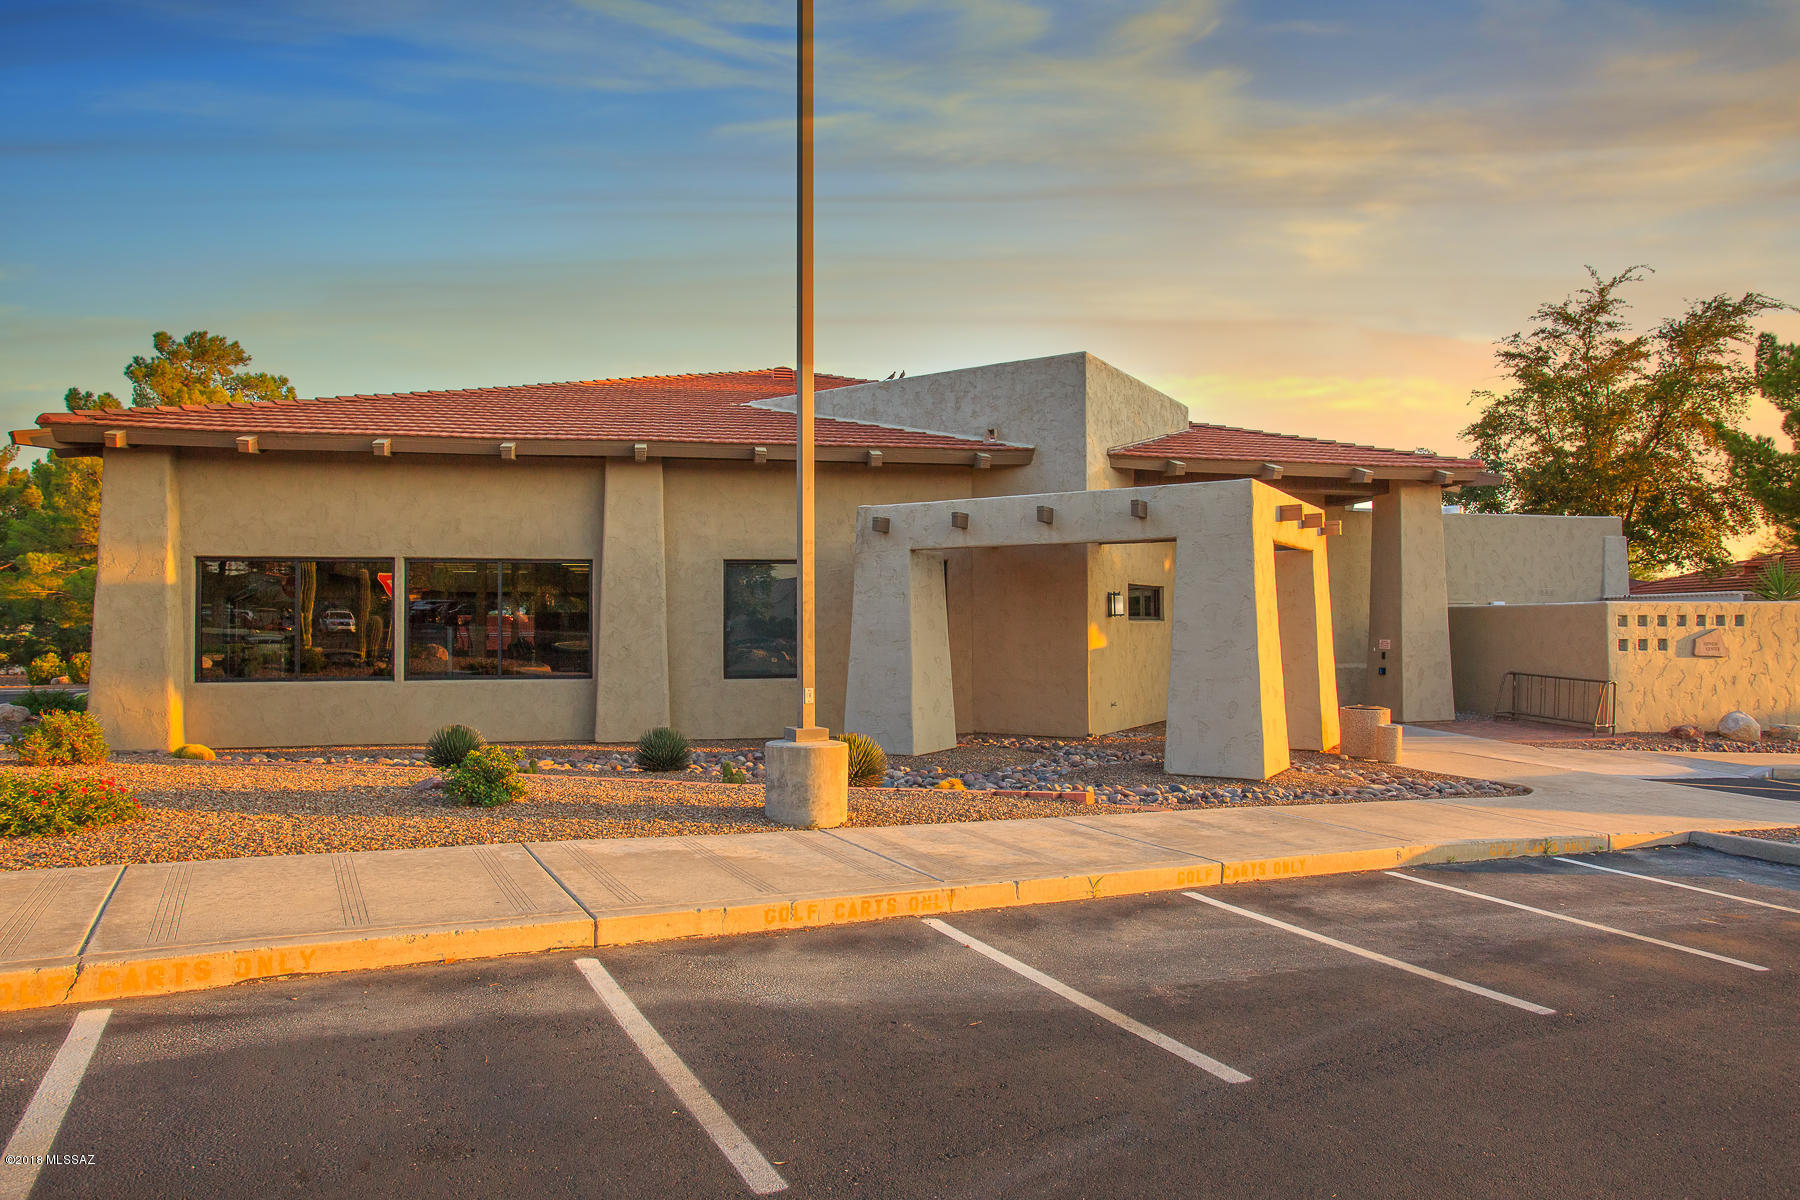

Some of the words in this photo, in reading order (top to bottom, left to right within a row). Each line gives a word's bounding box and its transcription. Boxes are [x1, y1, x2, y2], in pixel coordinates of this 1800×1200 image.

[1564, 839, 1591, 852] ONLY
[1176, 868, 1213, 886] GOLF
[1222, 862, 1267, 880] CARTS
[1273, 858, 1306, 875] ONLY
[763, 904, 818, 925] GOLF
[834, 897, 898, 919] CARTS
[908, 890, 957, 912] ONLY
[97, 959, 213, 994] CARTS
[233, 949, 318, 979] ONLY
